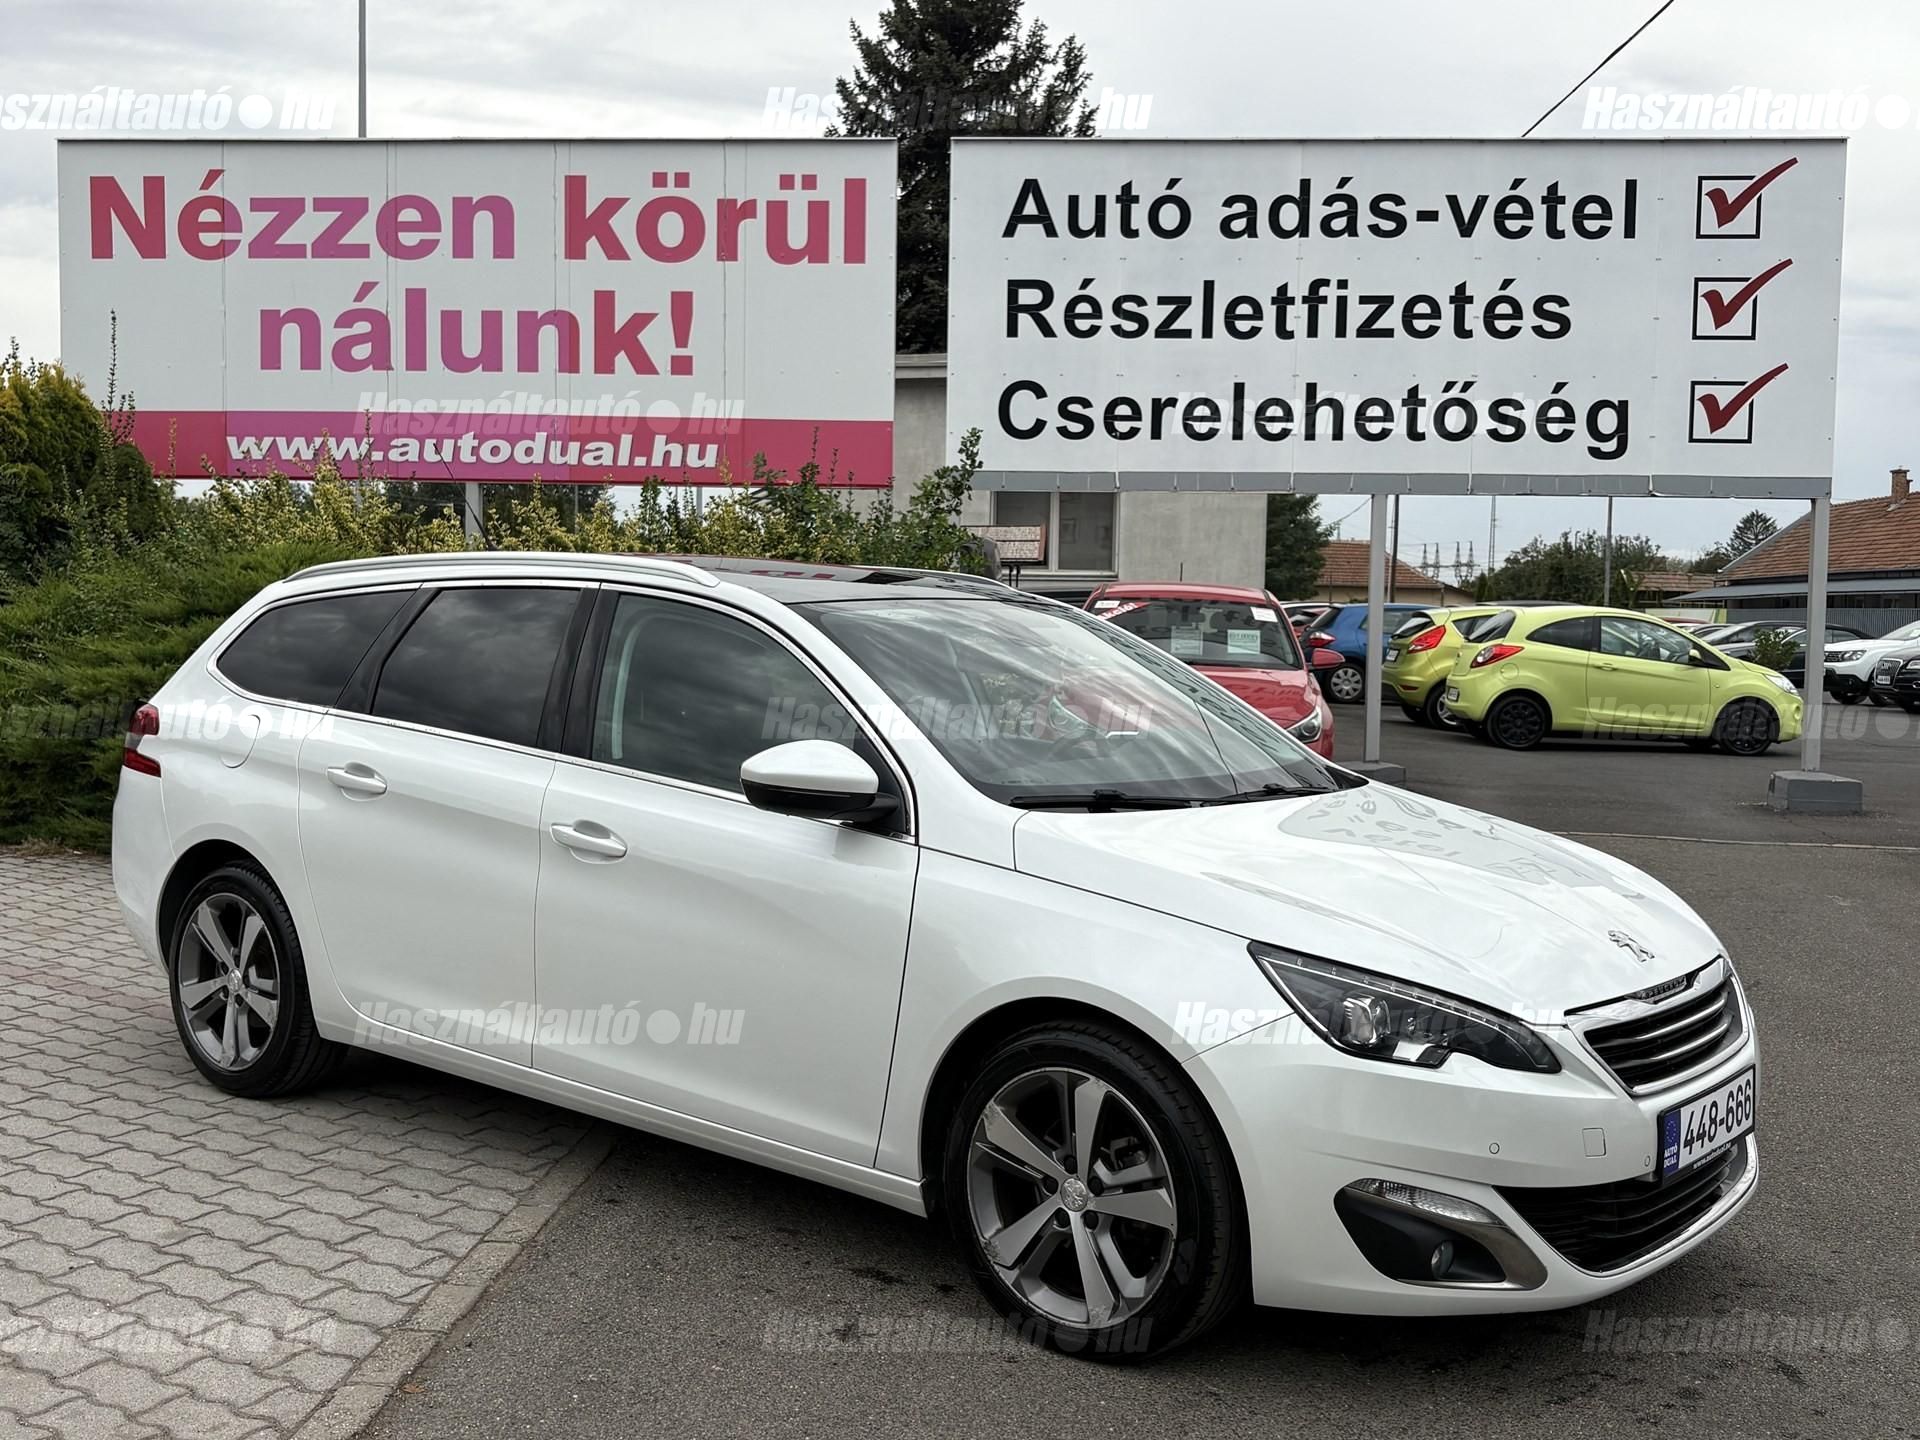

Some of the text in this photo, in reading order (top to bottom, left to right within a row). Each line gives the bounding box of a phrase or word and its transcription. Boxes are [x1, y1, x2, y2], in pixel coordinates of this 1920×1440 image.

[90, 169, 867, 265] Nézzen körül
[1001, 176, 1638, 240] Autó adás-vétel
[260, 282, 694, 376] nálunk!
[1006, 277, 1572, 341] Részletfizetés
[226, 431, 719, 469] www.autodual.hu
[998, 379, 1629, 460] Cserelehetőség
[1683, 1078, 1752, 1155] 448-666
